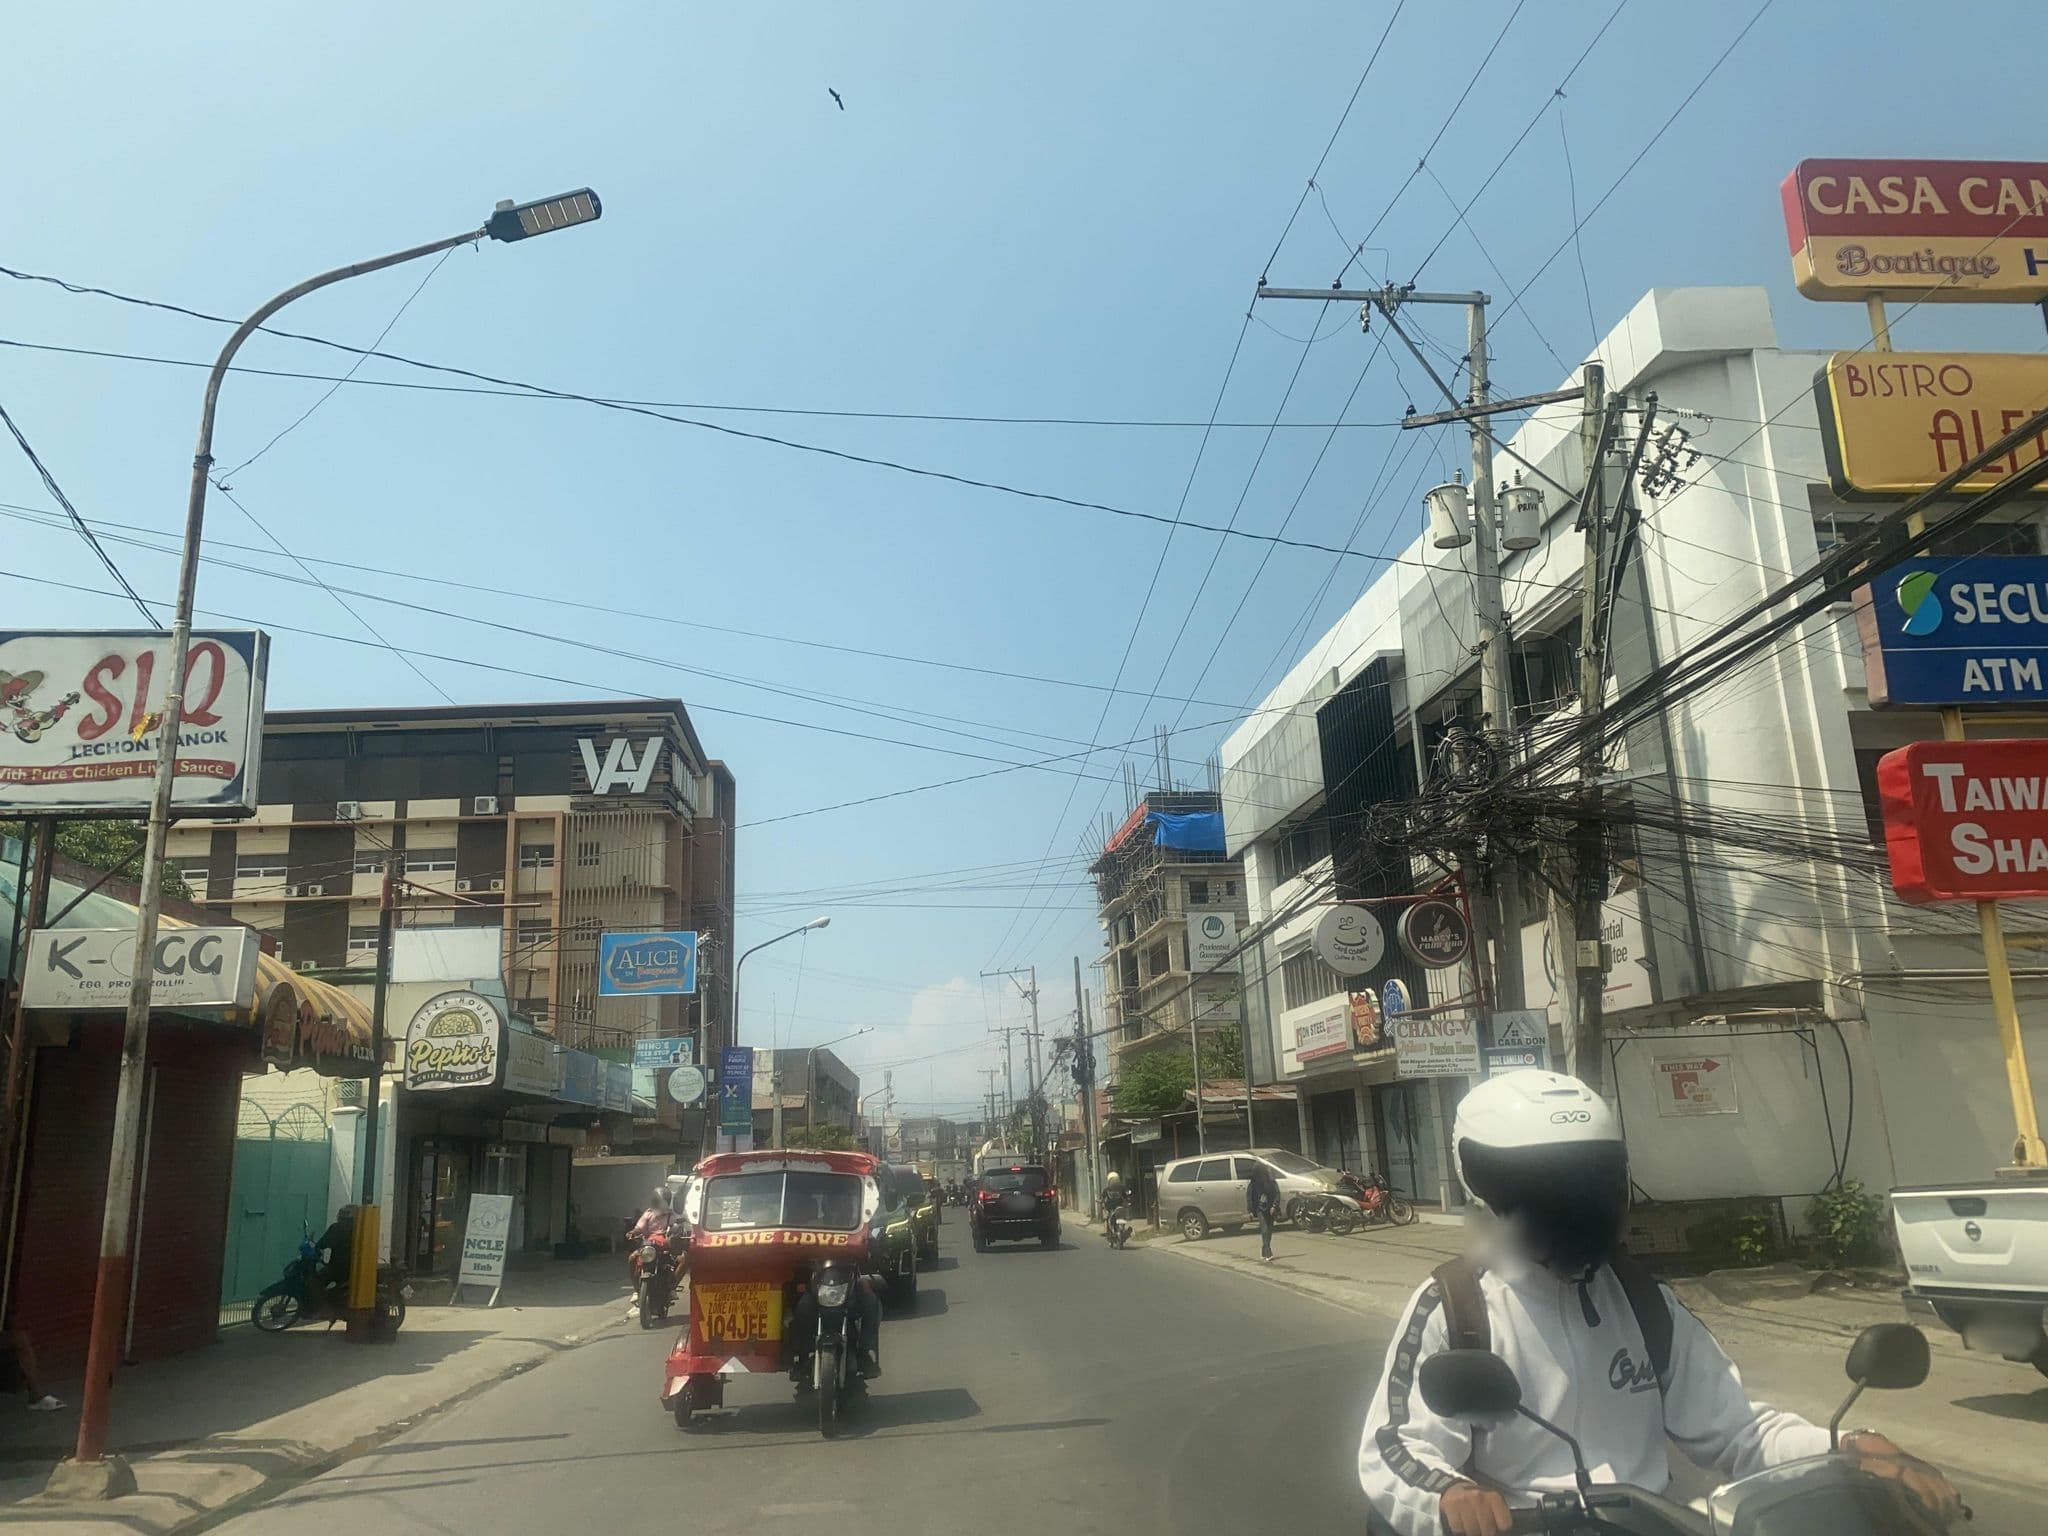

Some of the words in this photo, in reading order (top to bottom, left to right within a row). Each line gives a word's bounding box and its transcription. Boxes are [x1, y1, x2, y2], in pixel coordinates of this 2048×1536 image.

[1808, 176, 1949, 215] CASA
[1836, 245, 2000, 285] Boutique
[1845, 364, 1974, 398] BISTRO
[1962, 657, 2043, 693] ATM
[71, 736, 149, 759] LECHON
[32, 765, 68, 780] Pure
[72, 762, 133, 778] Chicken
[180, 760, 224, 775] Sauce
[616, 949, 679, 969] ALICE
[109, 980, 132, 989] DRO
[416, 1001, 449, 1030] PIZZA
[458, 996, 494, 1025] HOUSE
[1310, 1021, 1326, 1036] STEEL
[1498, 1039, 1523, 1047] CASA
[1526, 1037, 1546, 1045] DON
[408, 1036, 496, 1074] Pepito's
[1663, 1063, 1683, 1071] THIS
[1685, 1062, 1705, 1070] WAY
[1551, 1110, 1591, 1125] EVO
[465, 1239, 504, 1251] NCLE
[782, 1231, 849, 1246] LOVE
[463, 1251, 503, 1262] Laundry
[473, 1262, 492, 1272] Hub
